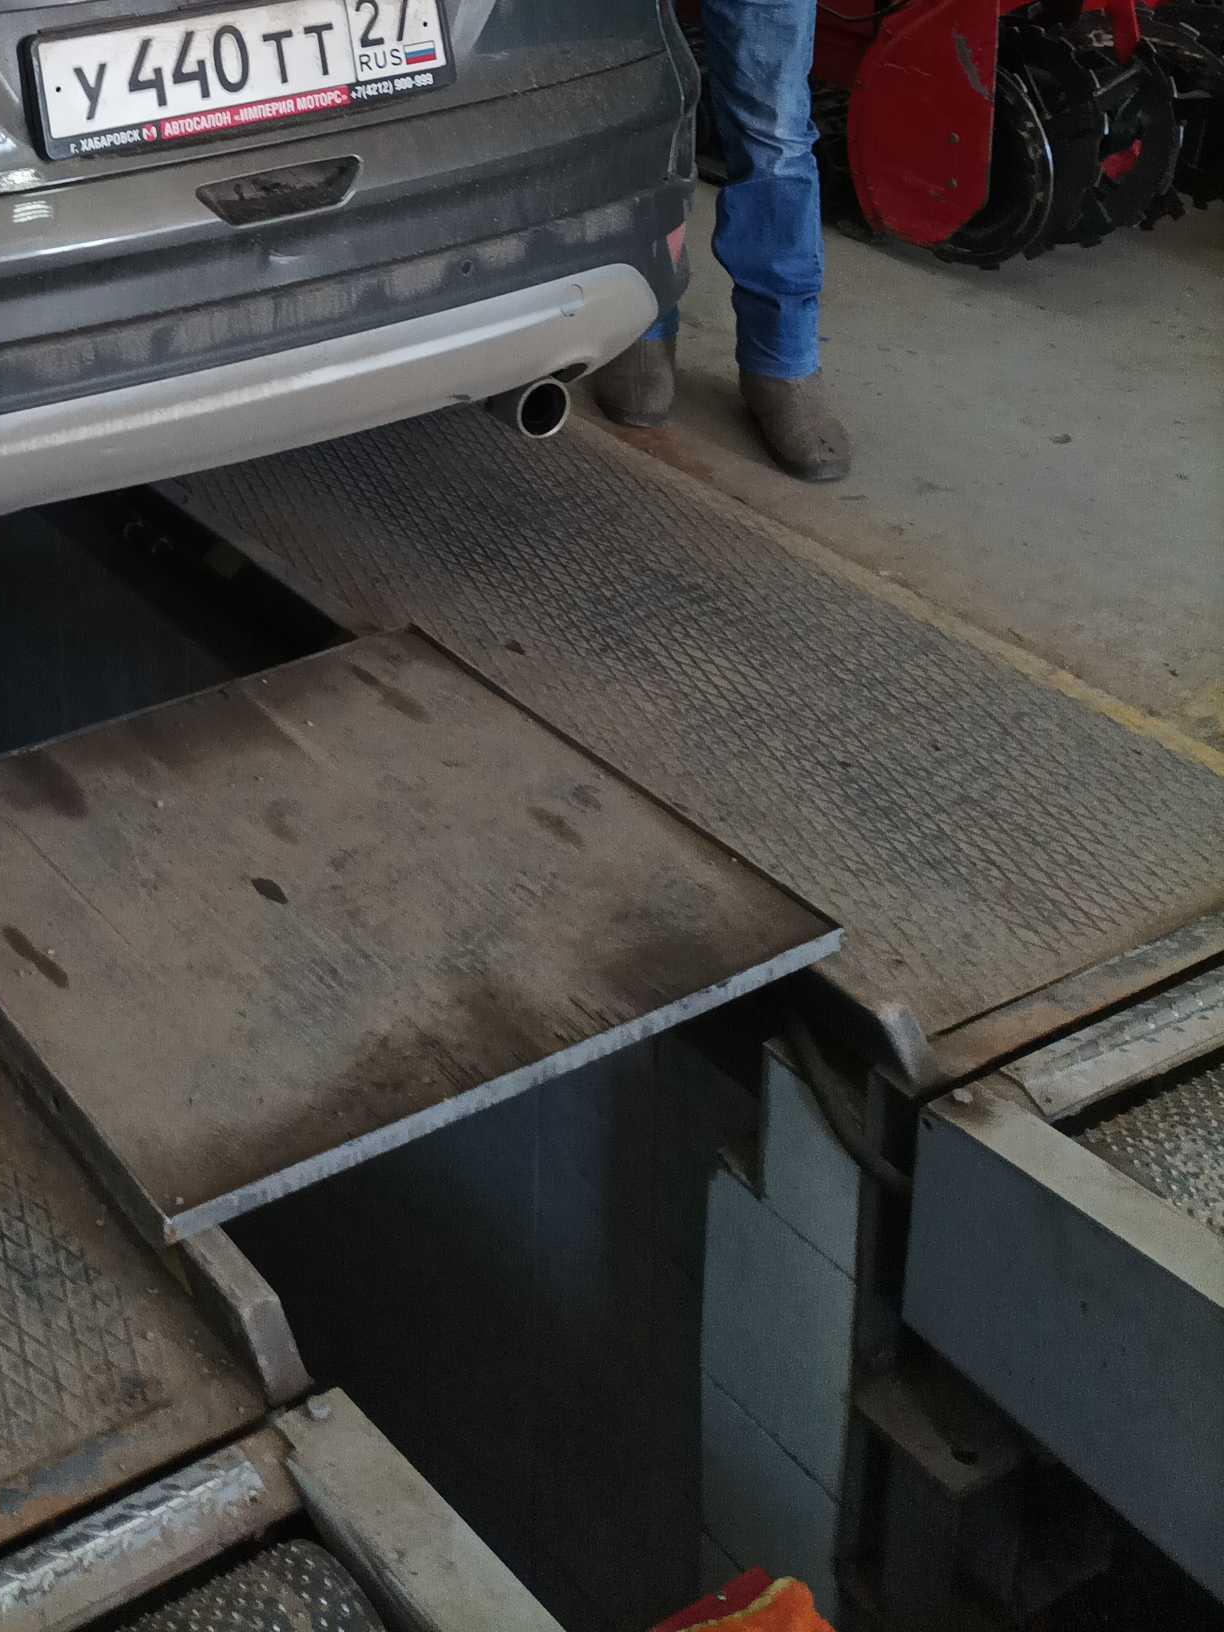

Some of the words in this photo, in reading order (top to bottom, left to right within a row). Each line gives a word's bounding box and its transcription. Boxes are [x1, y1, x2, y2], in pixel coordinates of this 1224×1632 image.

[359, 48, 403, 73] RUS
[80, 129, 141, 152] ХАБАРОВСК
[163, 111, 233, 137] АВТОСАЛОН
